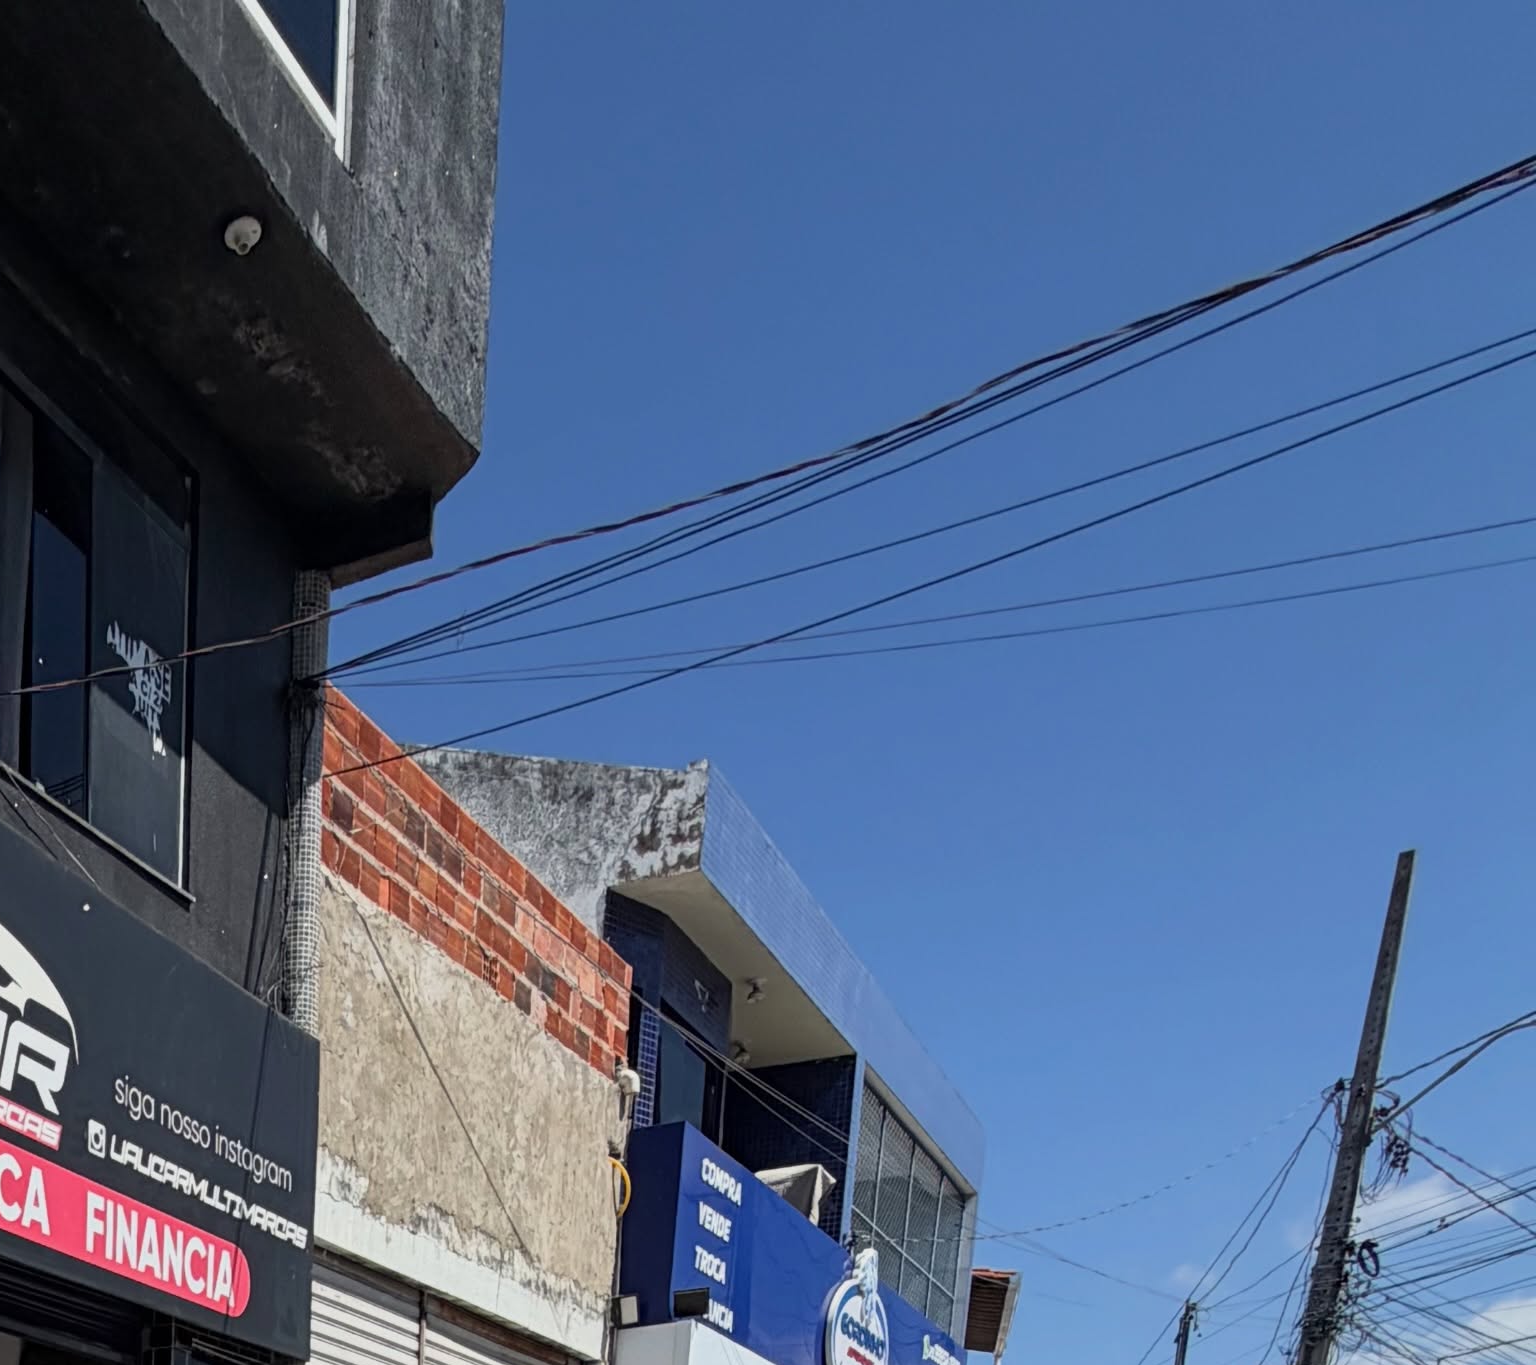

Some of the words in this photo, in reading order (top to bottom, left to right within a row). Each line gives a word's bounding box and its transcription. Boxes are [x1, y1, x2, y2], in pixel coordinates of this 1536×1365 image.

[114, 1075, 155, 1121] siga
[160, 1103, 211, 1149] nosso
[215, 1125, 293, 1193] instagram
[110, 1134, 308, 1250] UAUCARMULTIMARCAS
[698, 1201, 732, 1242] VENDE
[701, 1157, 742, 1206] COMPRA
[86, 1191, 235, 1308] FINANCIA
[695, 1245, 726, 1285] TROCA
